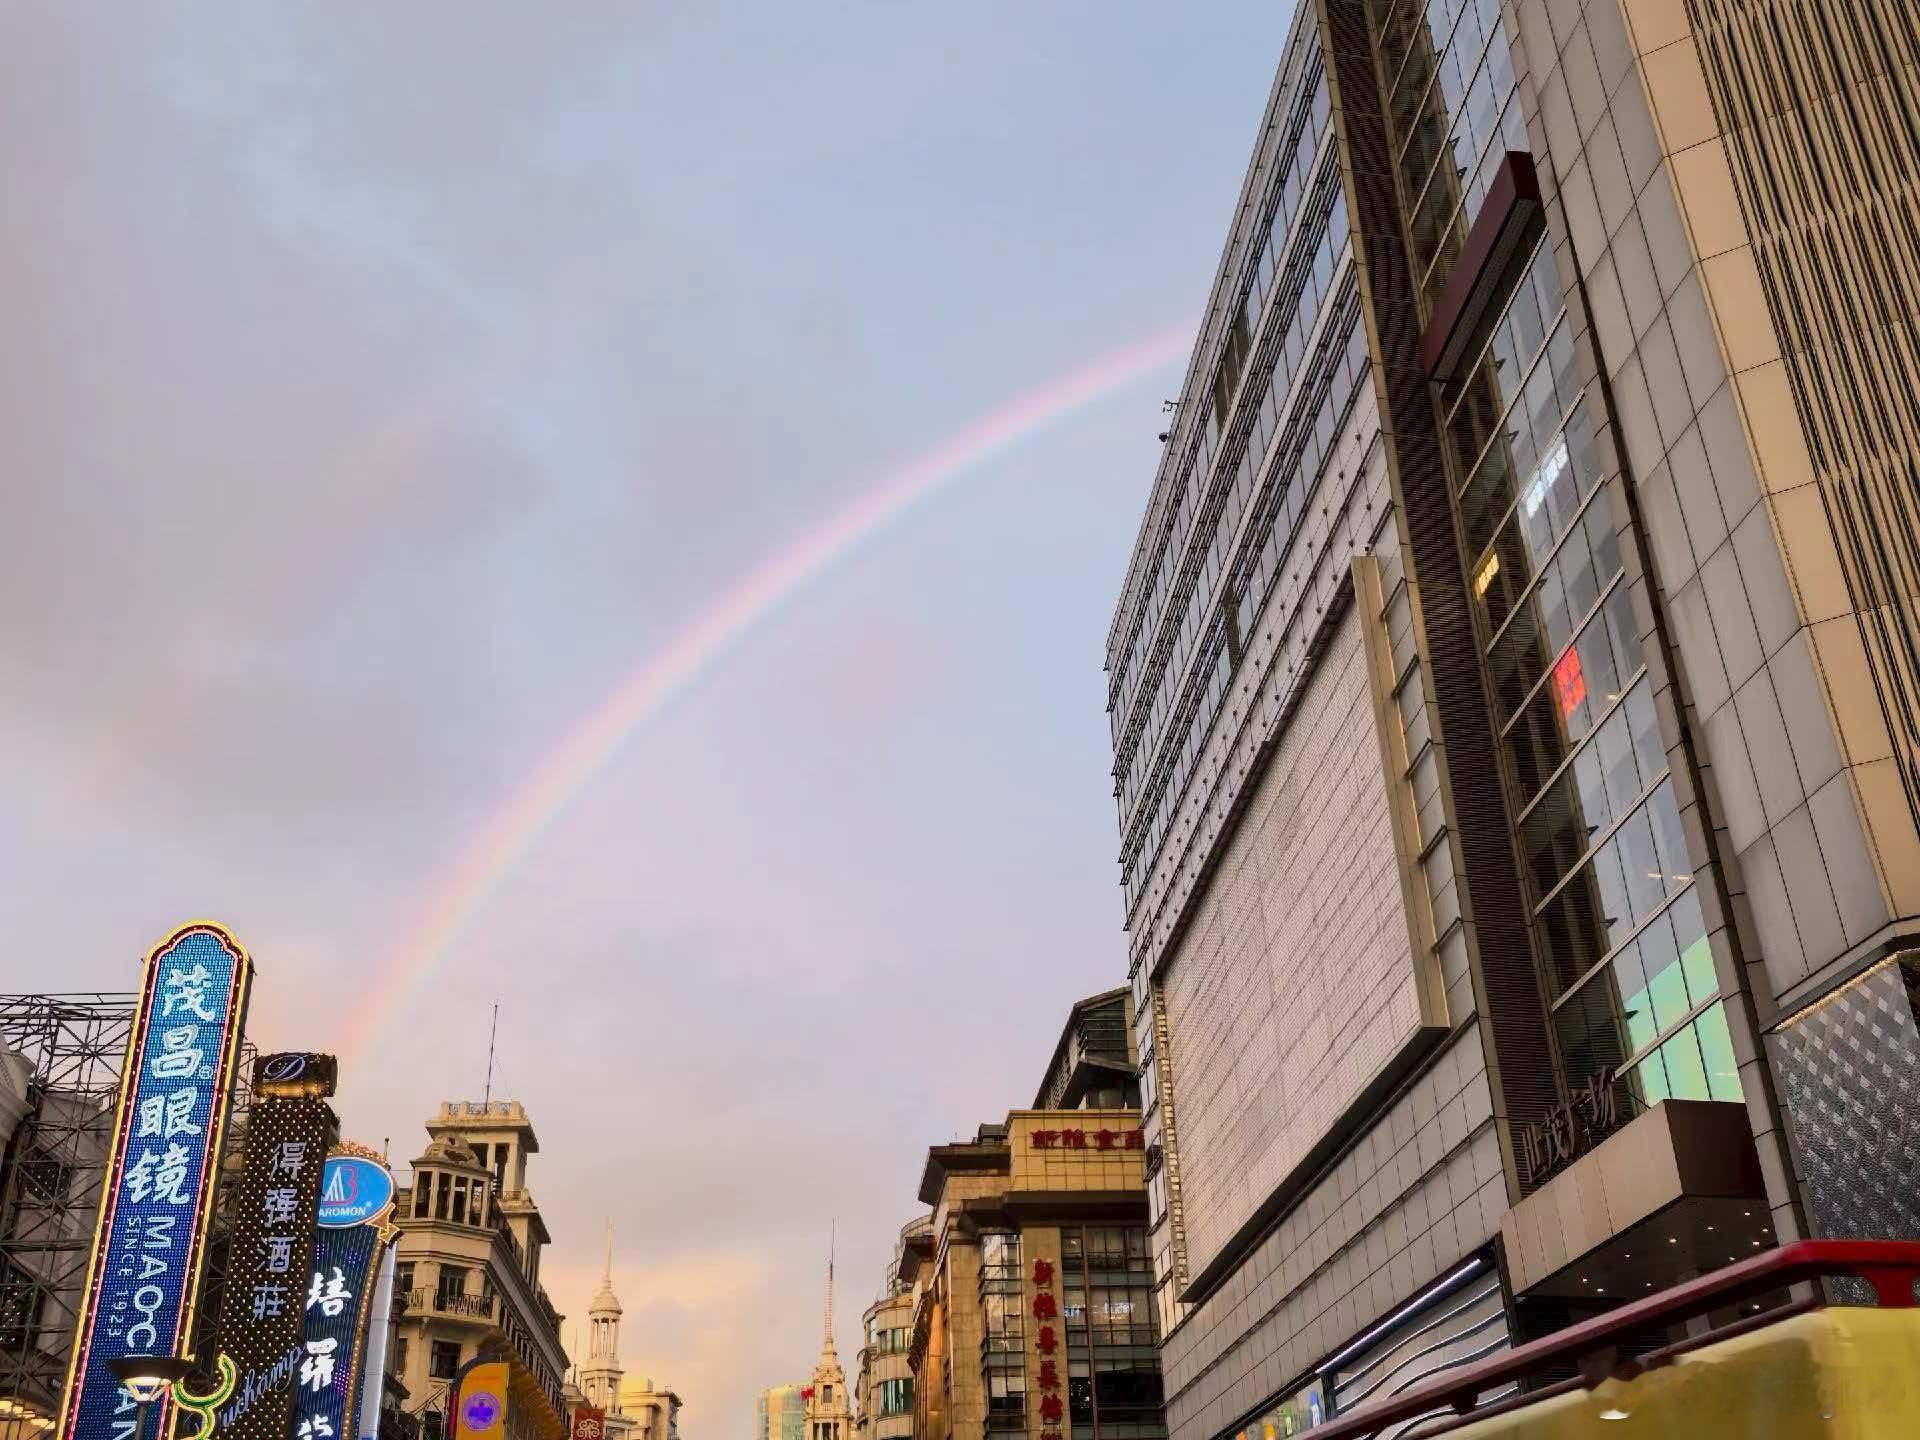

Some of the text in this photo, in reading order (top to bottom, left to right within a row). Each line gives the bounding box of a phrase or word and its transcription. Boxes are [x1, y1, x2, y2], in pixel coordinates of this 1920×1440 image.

[125, 964, 215, 1205] 茂昌眼镜
[107, 1217, 142, 1336] SINCE 1923
